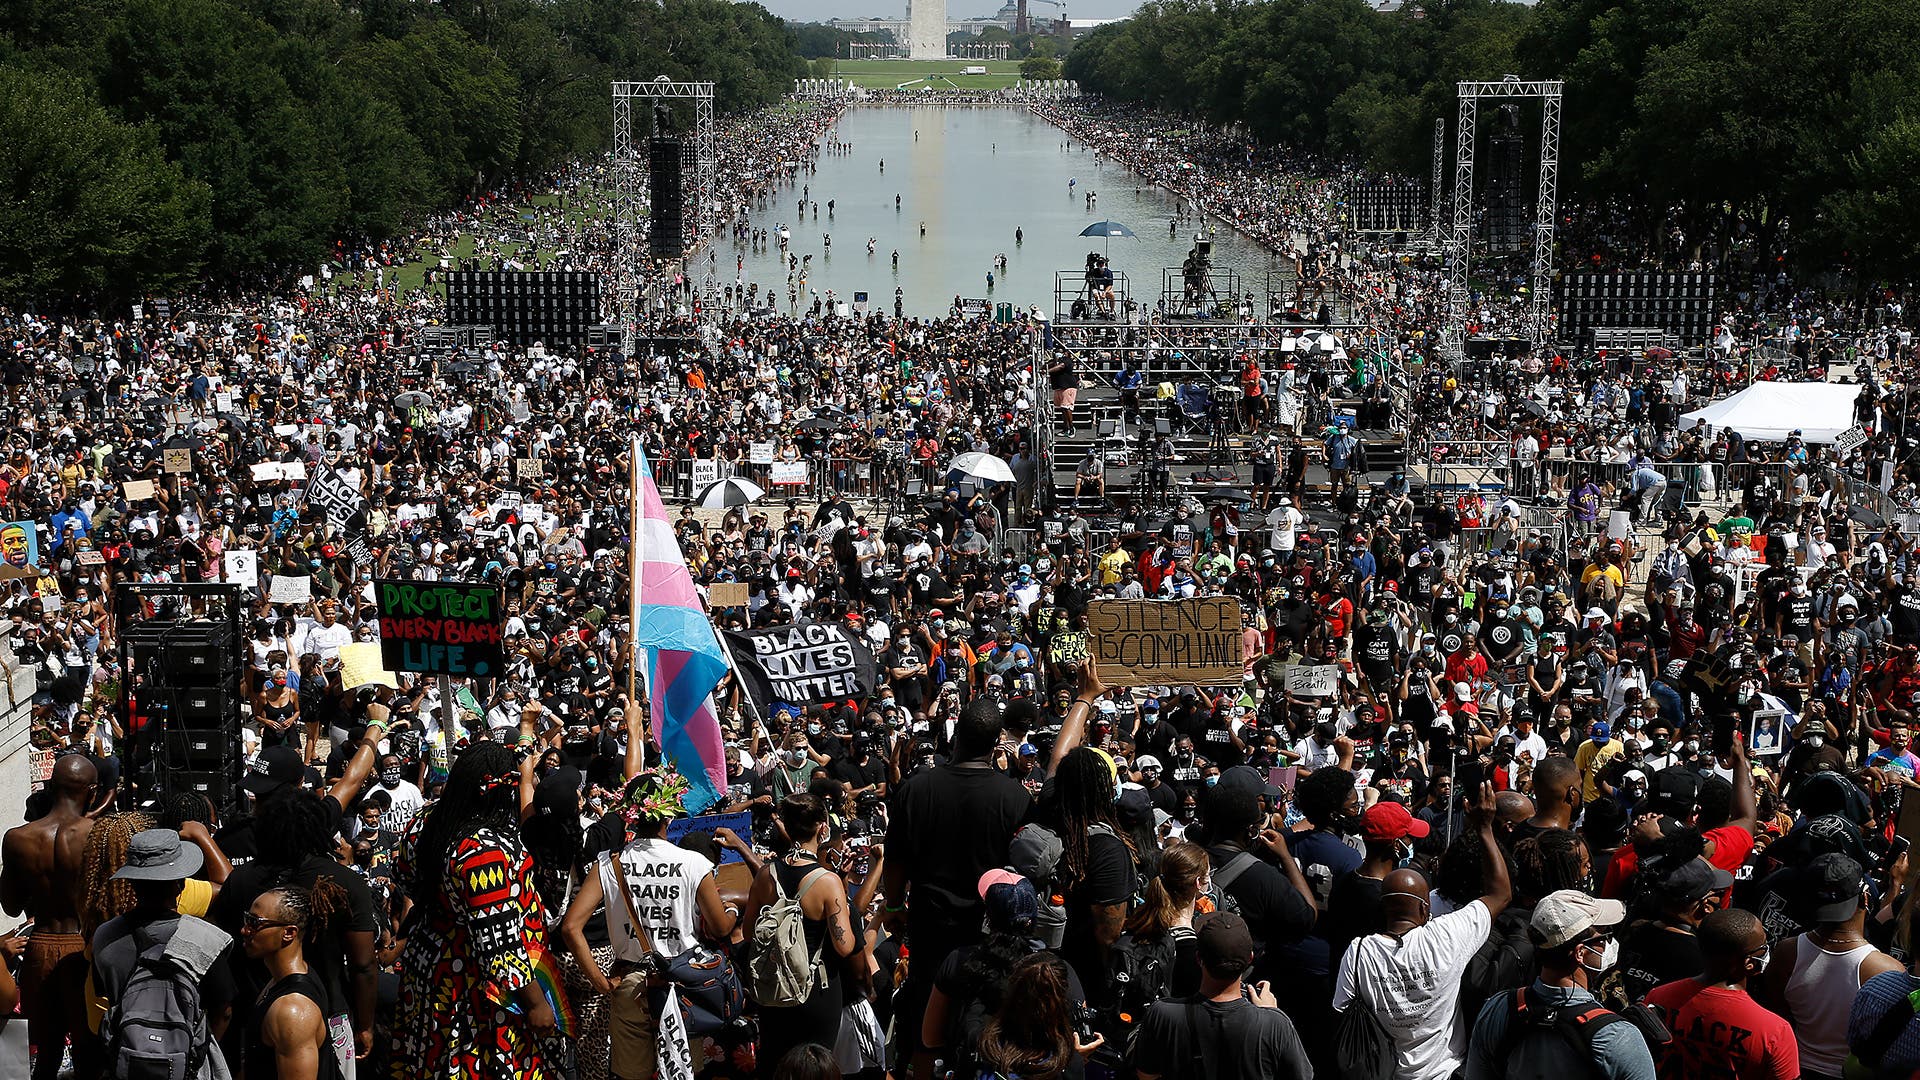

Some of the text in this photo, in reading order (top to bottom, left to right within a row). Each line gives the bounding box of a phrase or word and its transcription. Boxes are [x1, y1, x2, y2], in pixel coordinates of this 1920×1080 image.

[1838, 427, 1858, 440] BLACK
[1840, 435, 1865, 450] MATTER
[696, 474, 714, 482] LIVES
[317, 464, 364, 510] BLACK
[383, 584, 495, 619] PROTECT
[1098, 601, 1239, 632] SILENCE
[380, 617, 502, 644] EVERY BLACK
[750, 624, 847, 654] BLACK
[1053, 649, 1088, 662] NECK
[1100, 633, 1242, 669] IS COMPLIANCE
[760, 645, 852, 676] LIVES
[1289, 665, 1330, 678] I can't
[594, 674, 610, 687] adidas
[771, 671, 860, 702] MATTER
[1292, 677, 1328, 690] Breath
[46, 752, 55, 760] US
[390, 799, 413, 812] LACK
[232, 857, 244, 866] are
[630, 884, 680, 900] RANS
[637, 905, 672, 920] VES
[1627, 968, 1660, 986] ESIST
